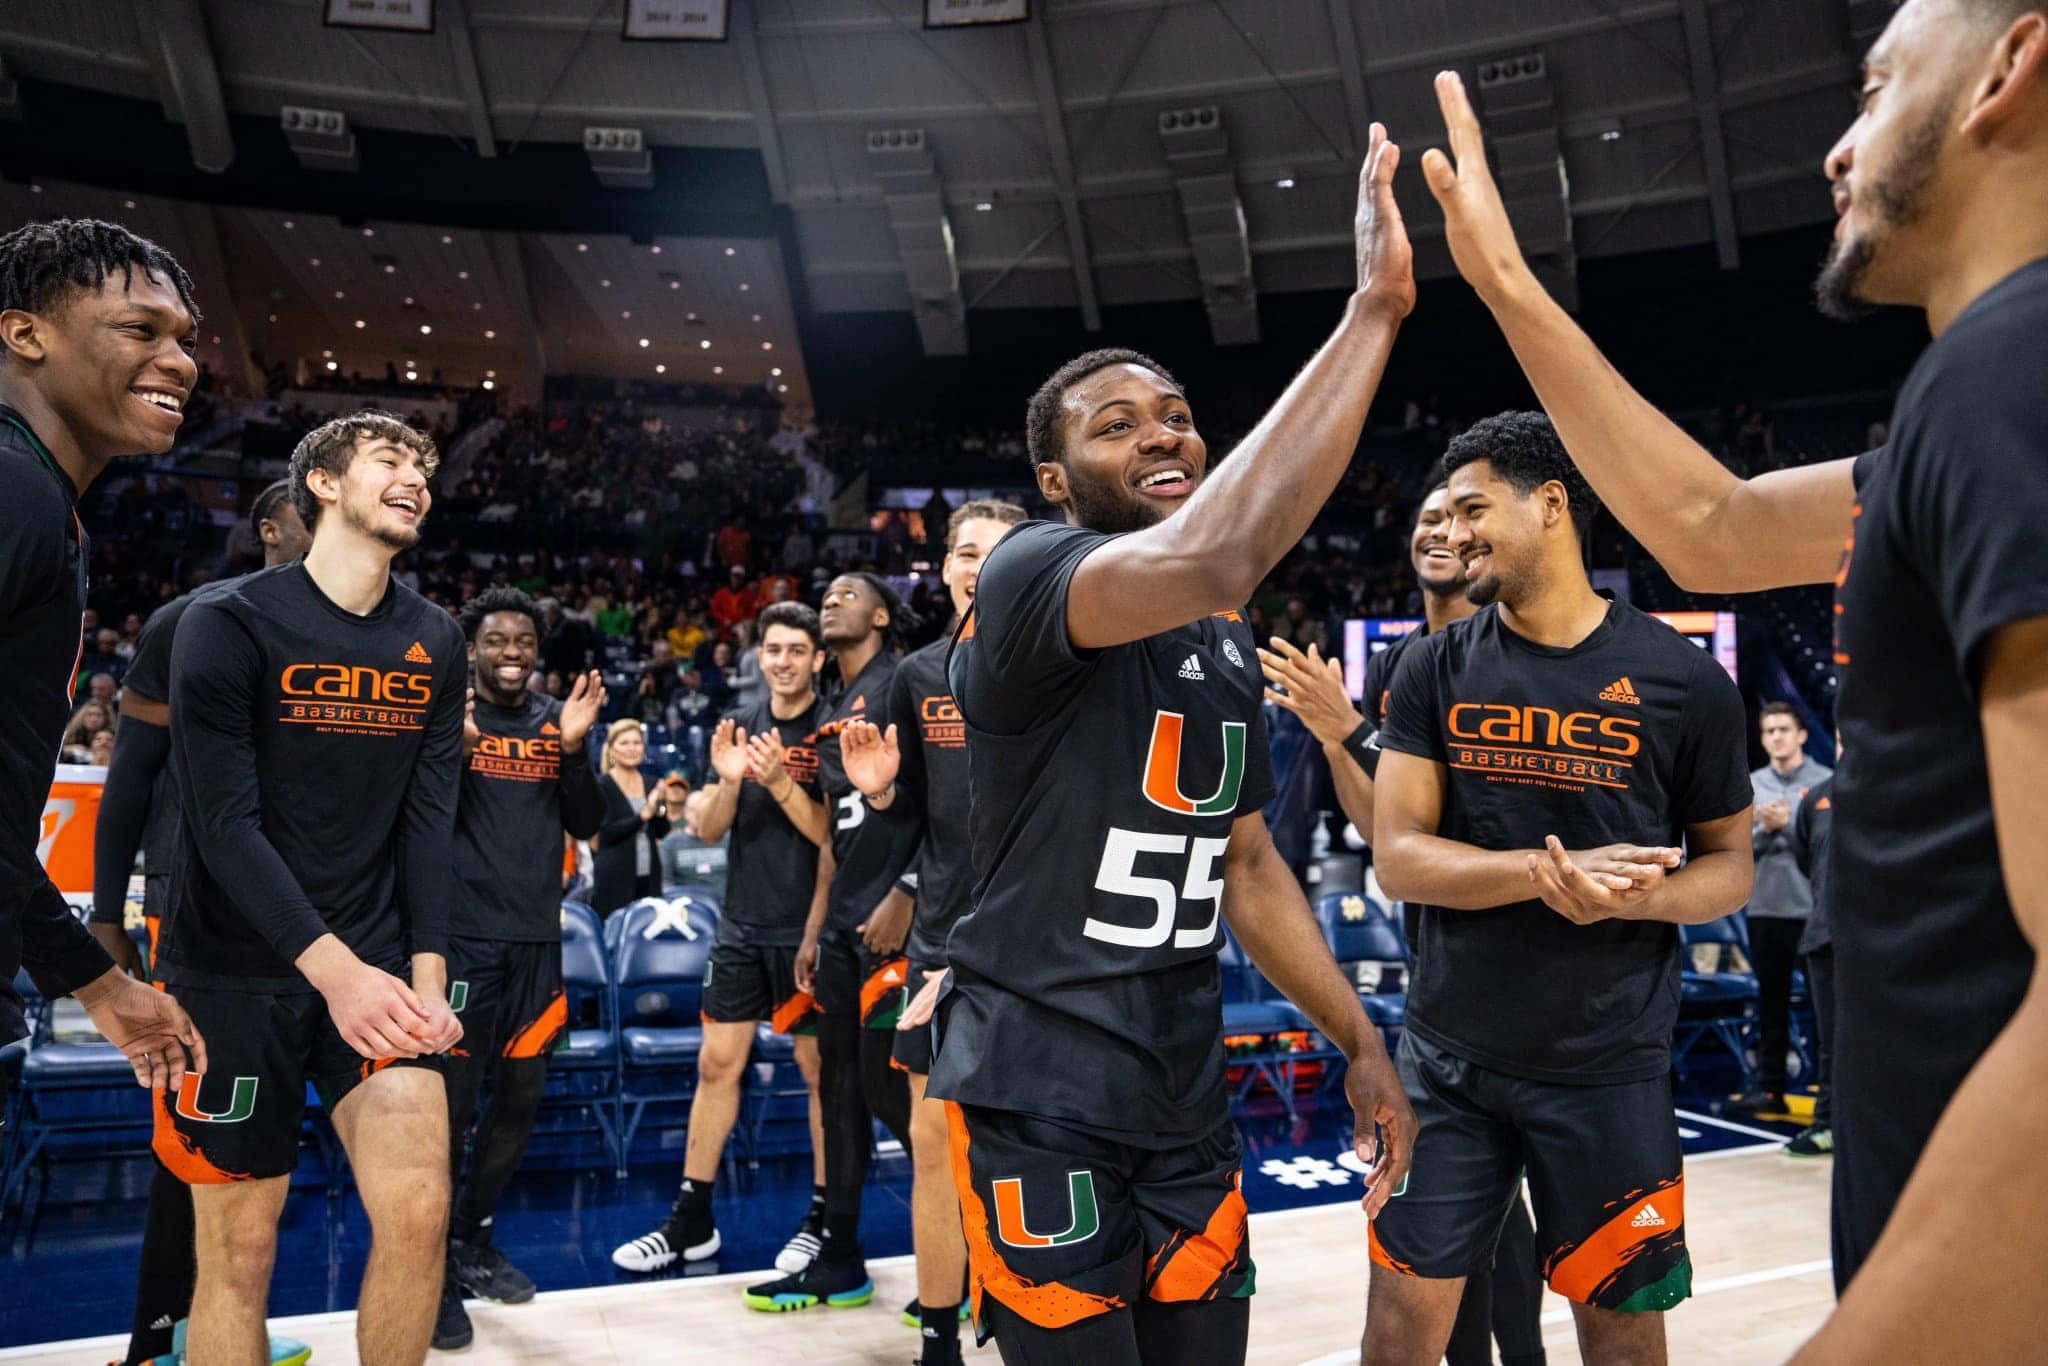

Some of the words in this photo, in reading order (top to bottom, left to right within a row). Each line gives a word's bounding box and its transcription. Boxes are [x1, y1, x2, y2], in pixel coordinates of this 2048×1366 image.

[1178, 669, 1206, 681] adidas
[1599, 691, 1641, 705] adidas
[1141, 709, 1248, 818] U
[1082, 827, 1231, 949] 55
[175, 1071, 260, 1123] U
[991, 1169, 1101, 1249] U
[1631, 1217, 1666, 1228] adidas
